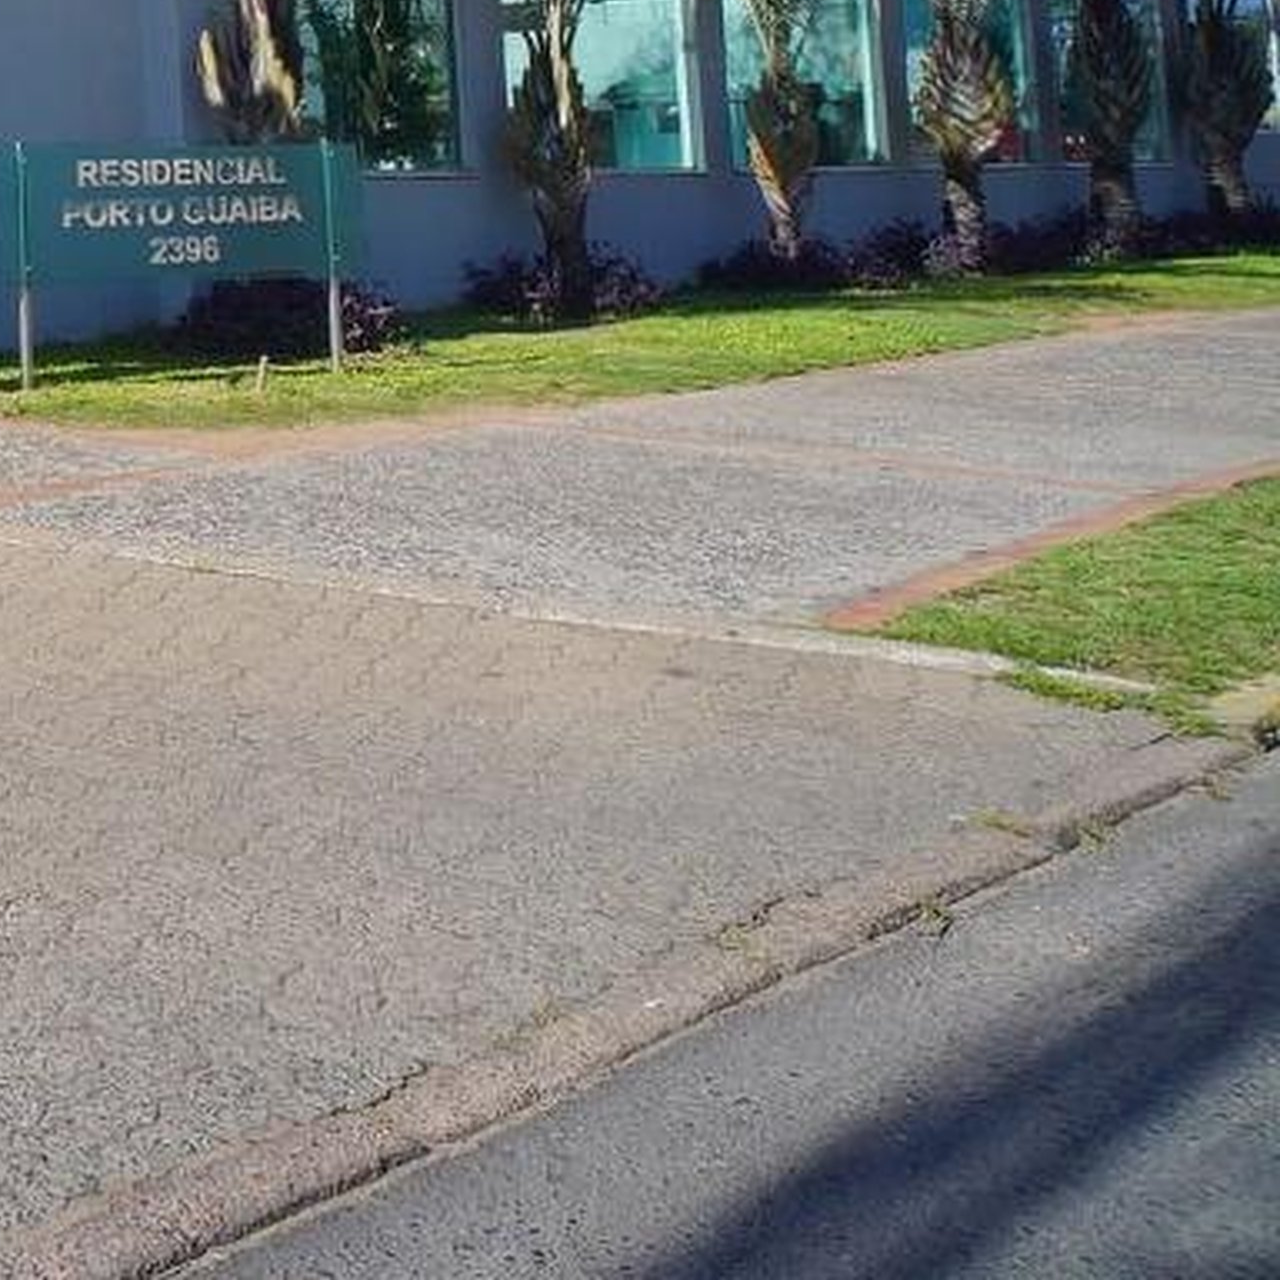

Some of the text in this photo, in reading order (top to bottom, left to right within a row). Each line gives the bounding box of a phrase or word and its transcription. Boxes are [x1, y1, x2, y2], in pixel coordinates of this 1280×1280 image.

[77, 157, 286, 187] RESIDENCIAL
[62, 199, 174, 227] PORTO
[149, 236, 220, 264] 2396
